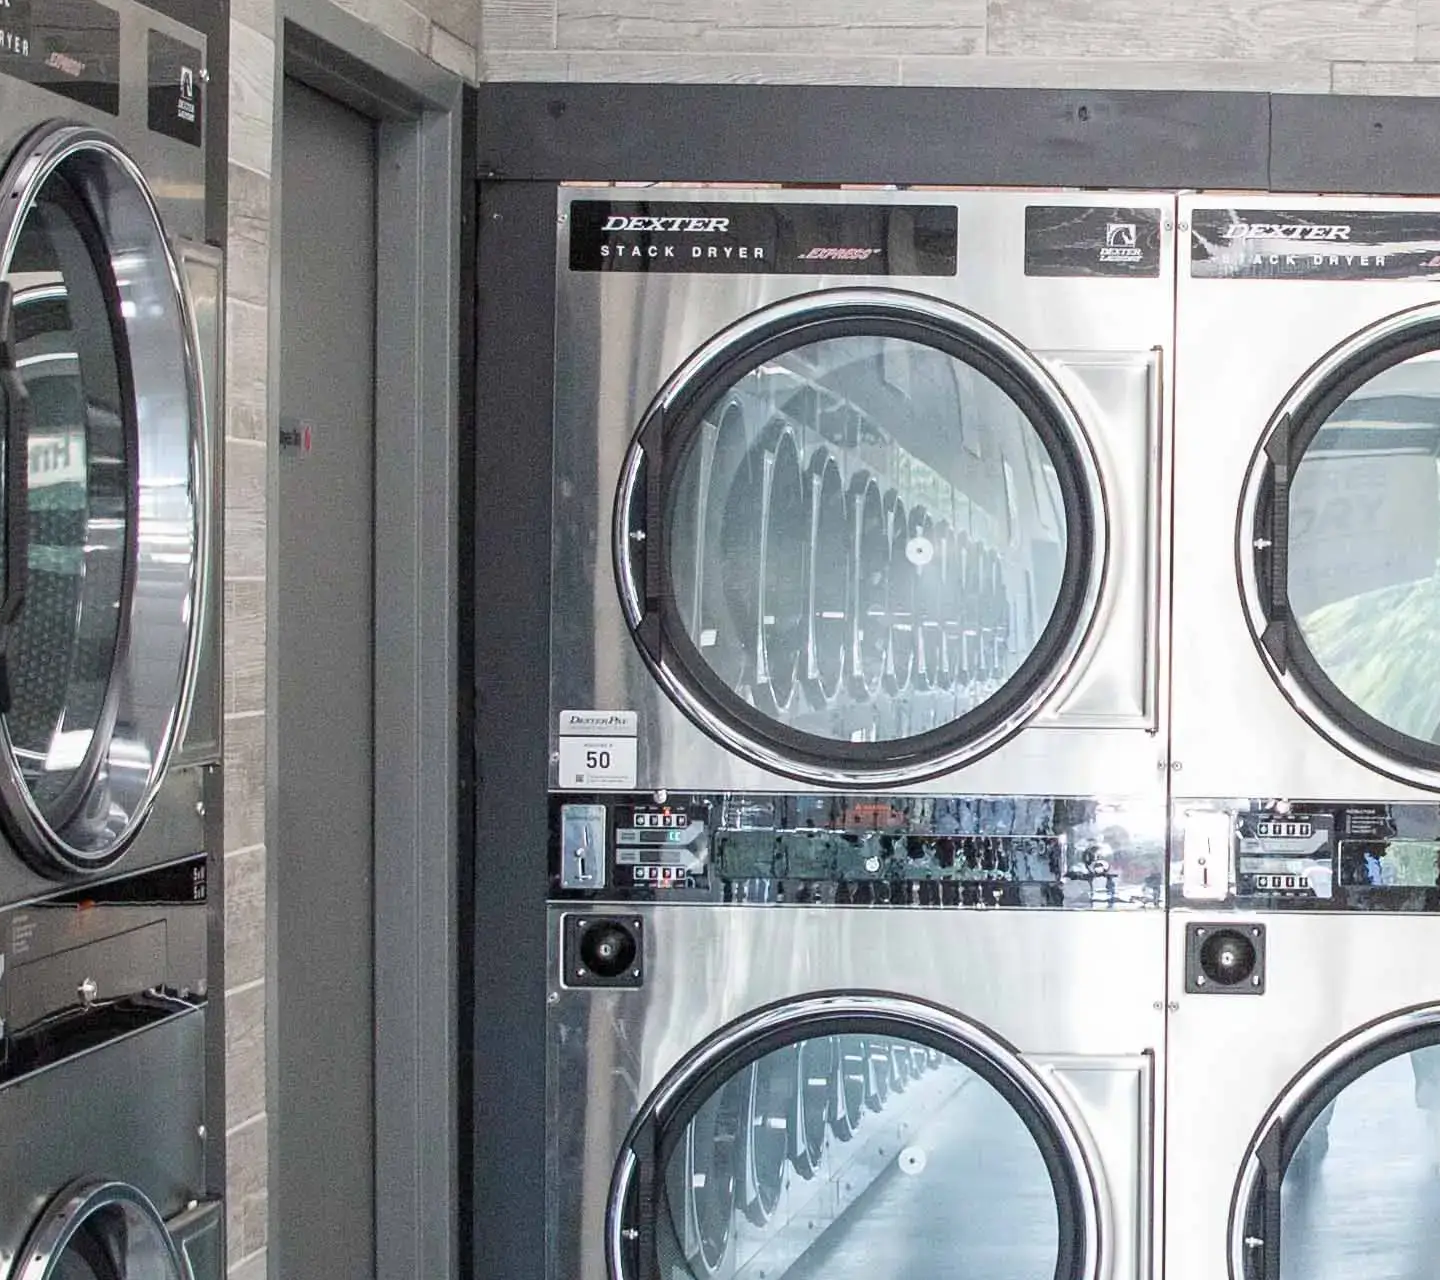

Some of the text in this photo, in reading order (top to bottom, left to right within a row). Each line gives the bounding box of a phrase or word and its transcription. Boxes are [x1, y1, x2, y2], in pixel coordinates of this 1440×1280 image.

[602, 216, 729, 231] DEXTER
[1222, 224, 1351, 240] DEXTER
[601, 246, 764, 258] STACK DRYER
[807, 248, 872, 259] EXPRESS
[1100, 248, 1143, 256] DEXTER
[1313, 255, 1385, 266] DRYER
[587, 752, 610, 768] 50
